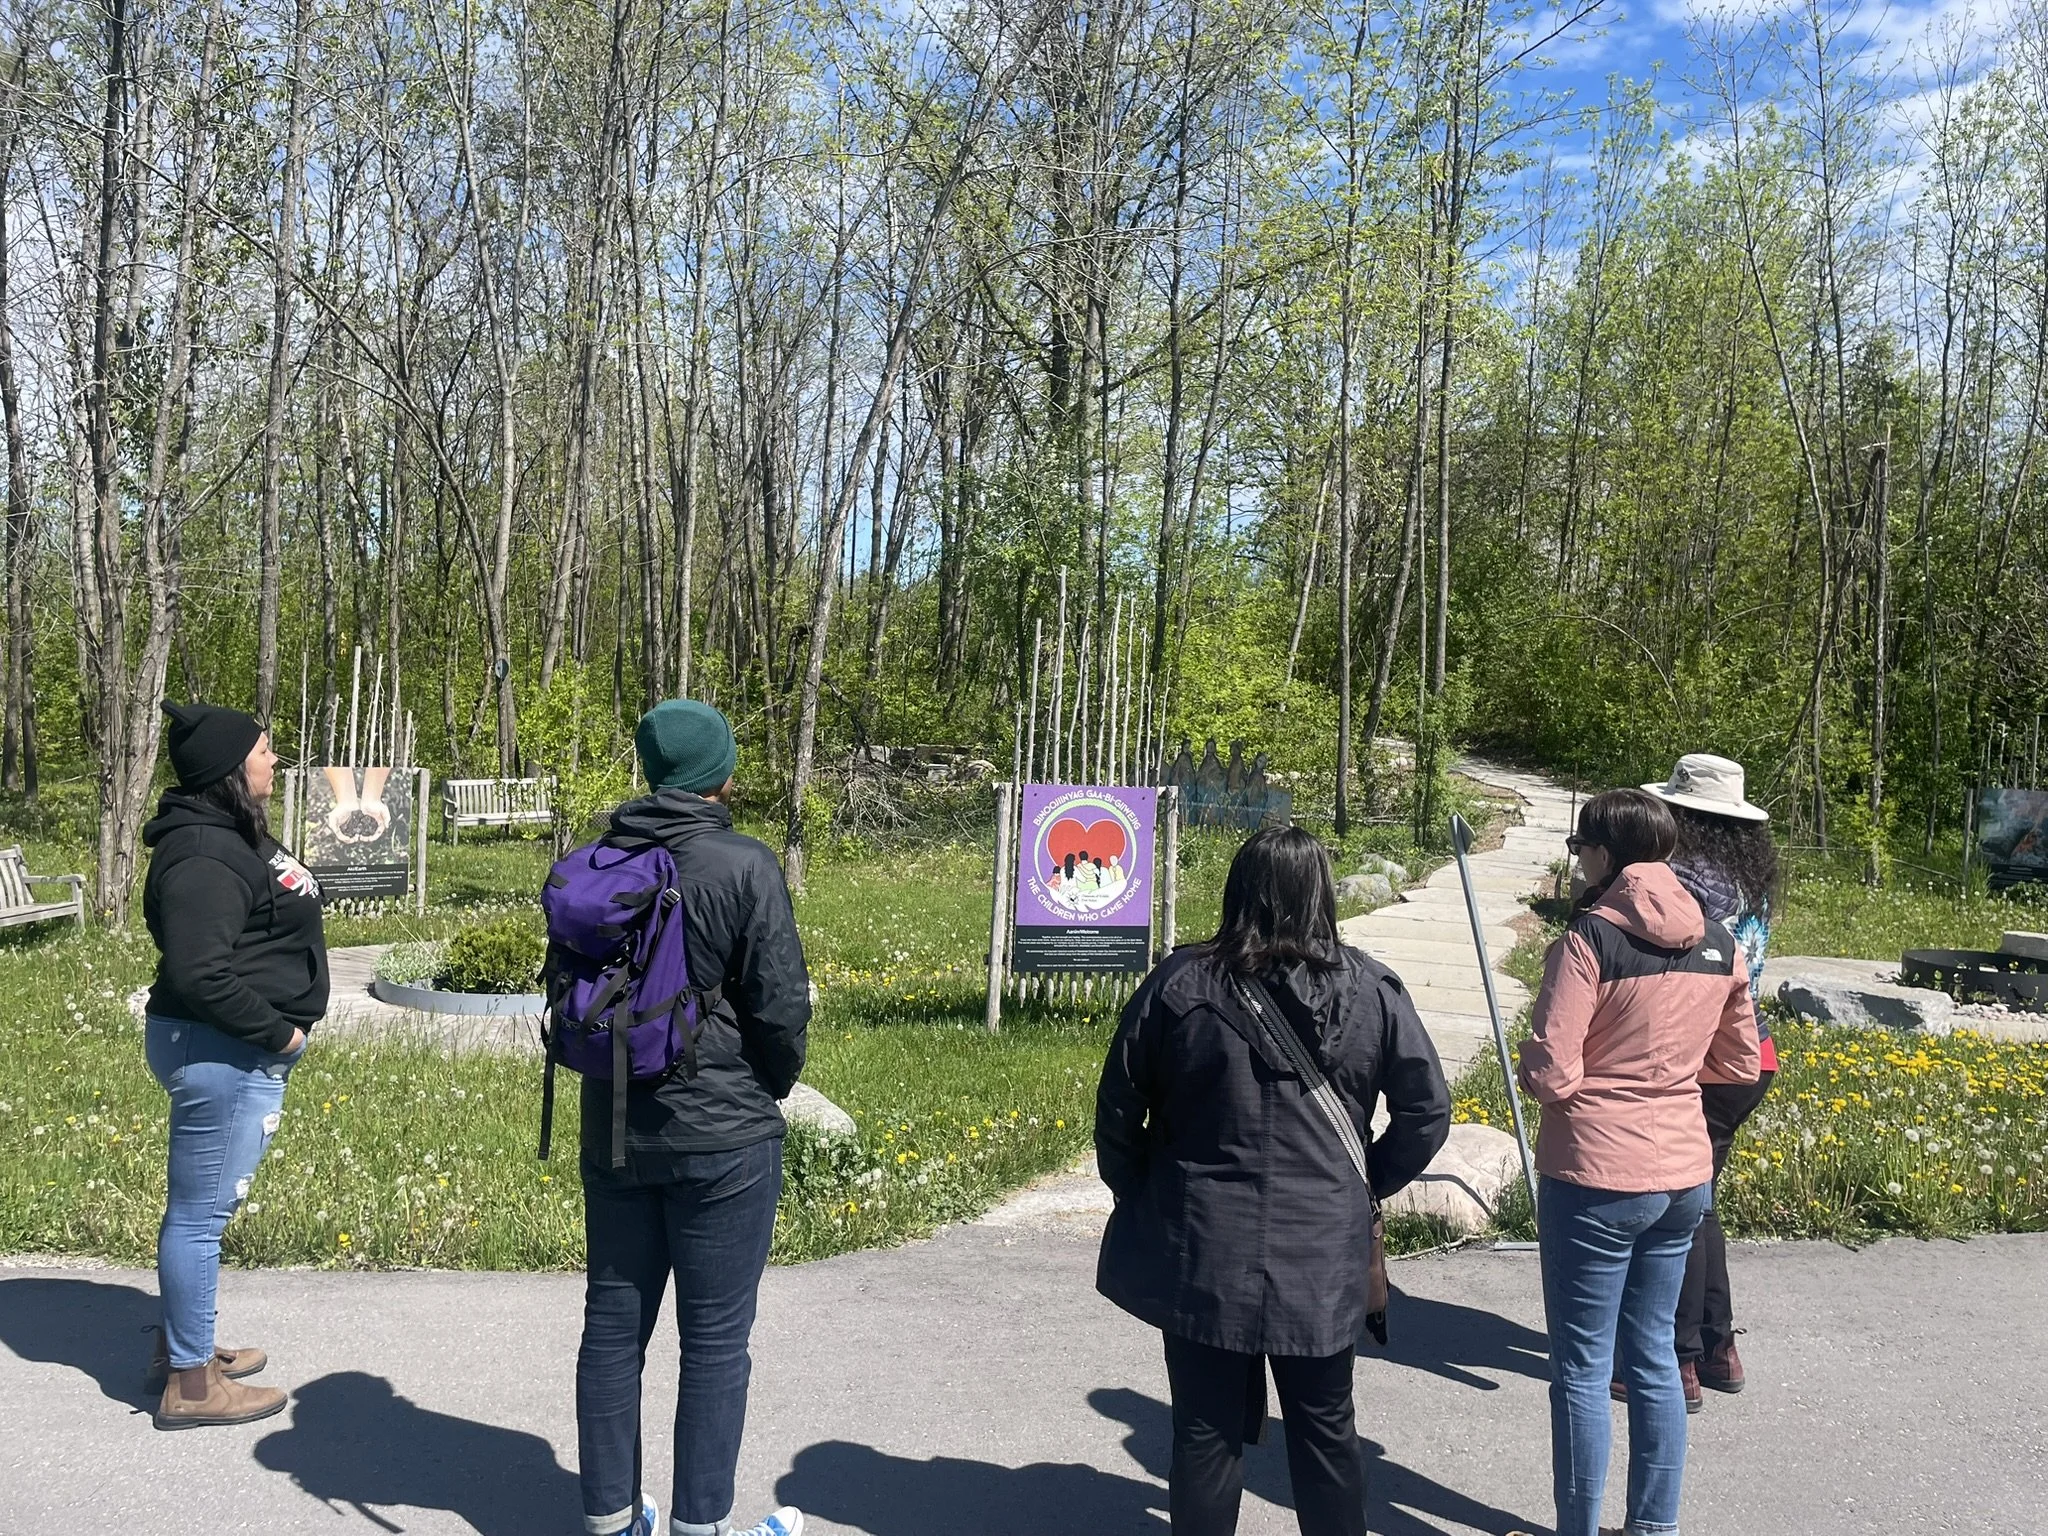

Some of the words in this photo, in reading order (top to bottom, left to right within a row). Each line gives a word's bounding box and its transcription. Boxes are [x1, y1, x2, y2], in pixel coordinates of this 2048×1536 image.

[1027, 876, 1040, 896] THE
[1037, 894, 1076, 921] CHILDREN
[1077, 912, 1099, 922] WHO
[1100, 900, 1124, 918] CAME
[1121, 877, 1142, 904] HOME
